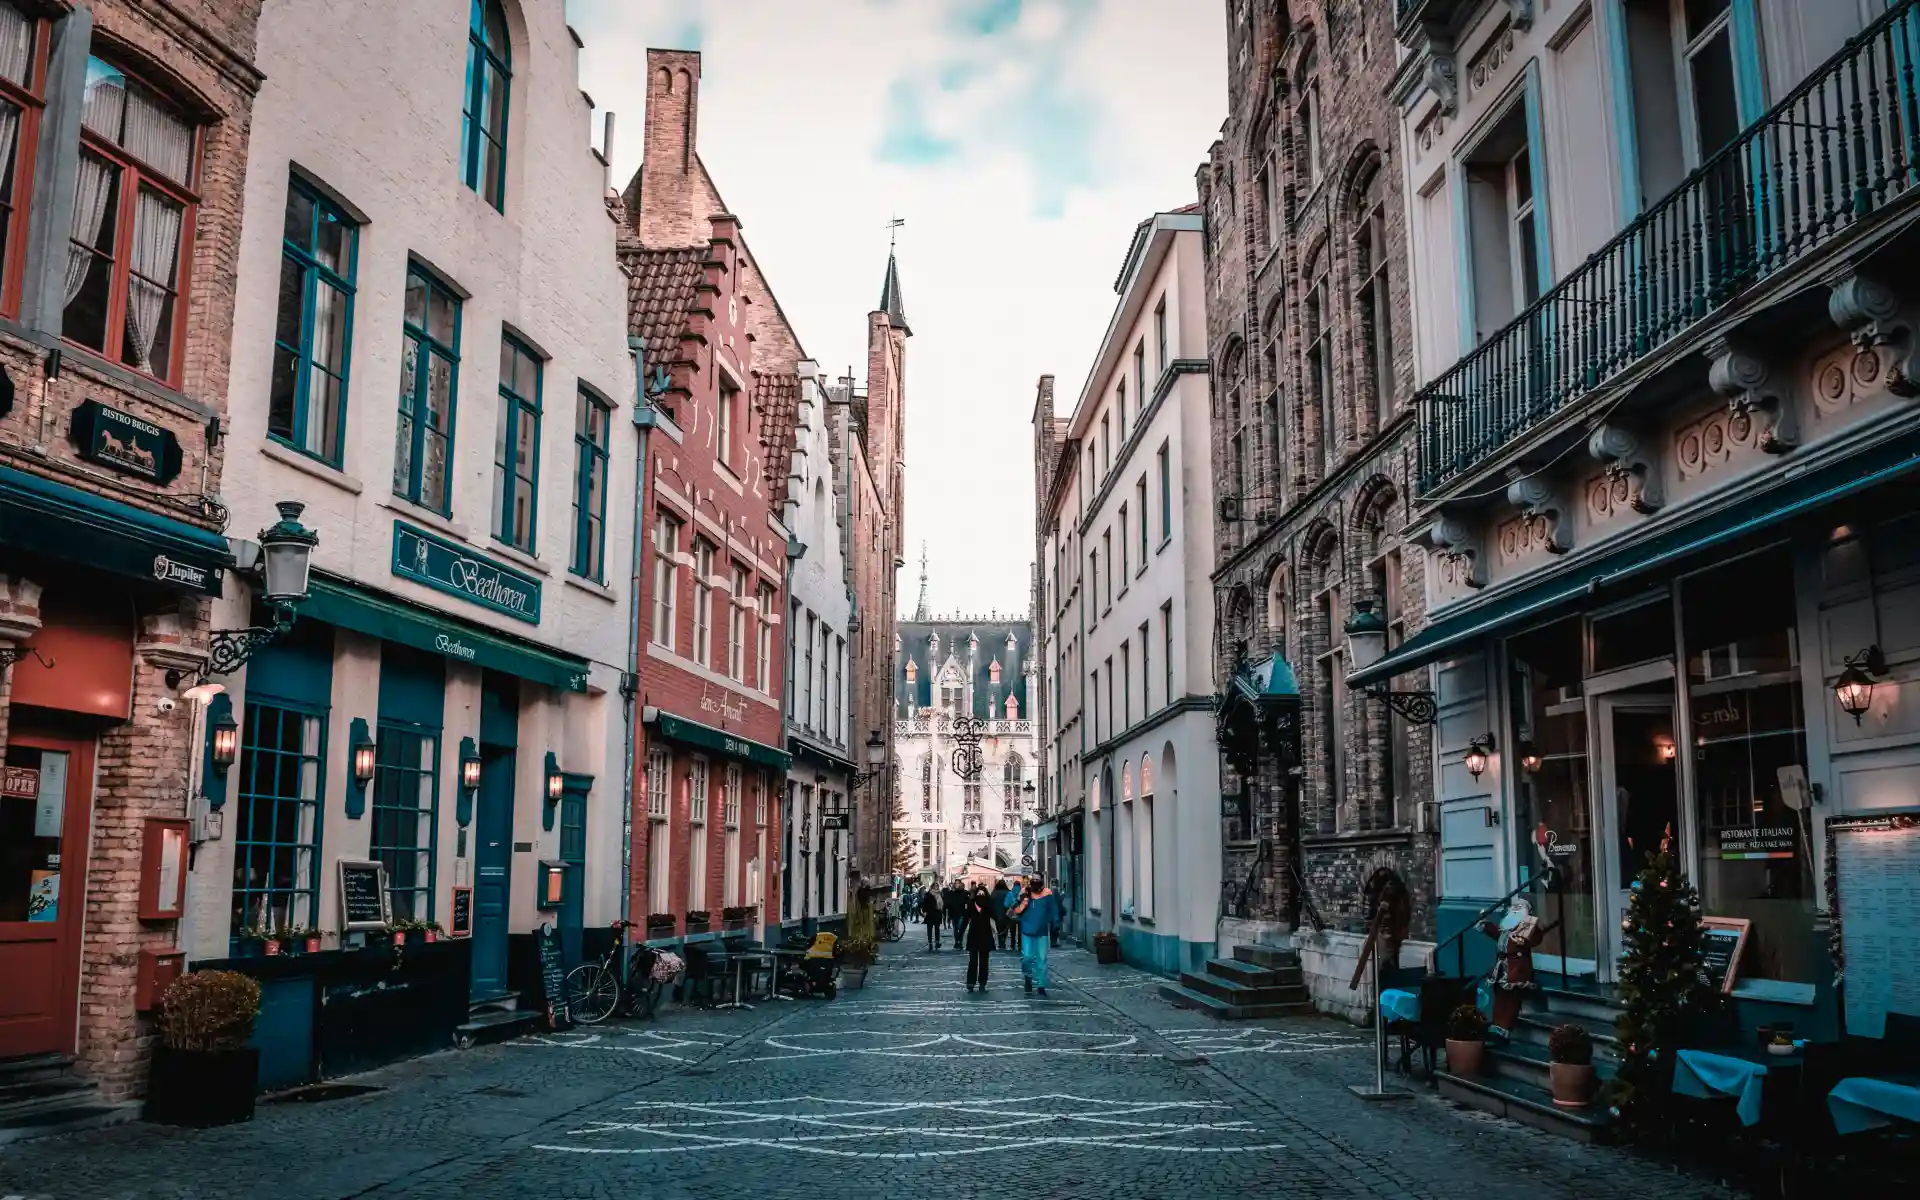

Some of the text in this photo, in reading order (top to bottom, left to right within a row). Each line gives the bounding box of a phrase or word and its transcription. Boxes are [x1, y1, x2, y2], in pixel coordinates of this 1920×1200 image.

[102, 408, 160, 437] BISTRO BRUGIS
[168, 563, 205, 583] Jupiler
[451, 554, 527, 611] Beethoven
[435, 632, 475, 659] Beethoven
[5, 777, 36, 793] OPEN
[1721, 827, 1793, 839] RISTORANTE ITALIANO
